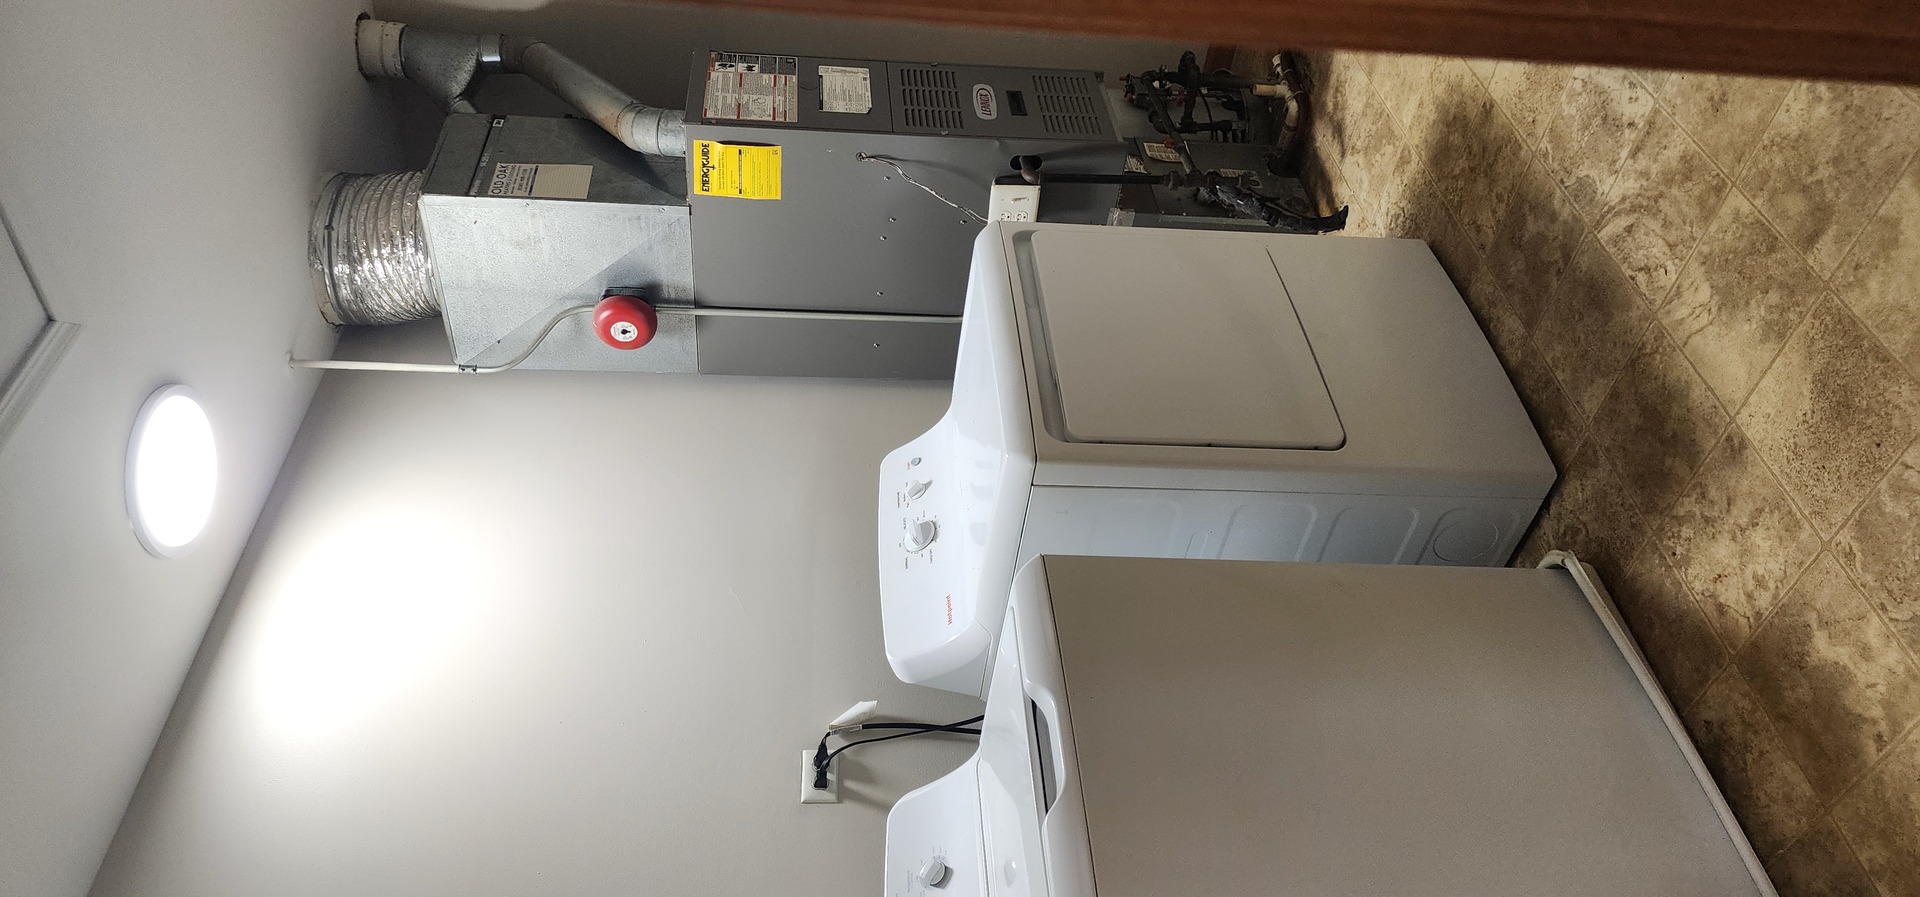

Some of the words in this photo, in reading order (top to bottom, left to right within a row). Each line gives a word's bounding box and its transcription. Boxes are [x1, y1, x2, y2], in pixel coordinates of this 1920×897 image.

[979, 93, 992, 116] LENNOX
[496, 164, 510, 179] OAK
[701, 143, 714, 192] ENERGYGUIDE
[491, 180, 504, 194] OLD
[945, 593, 953, 626] Hotpoint
